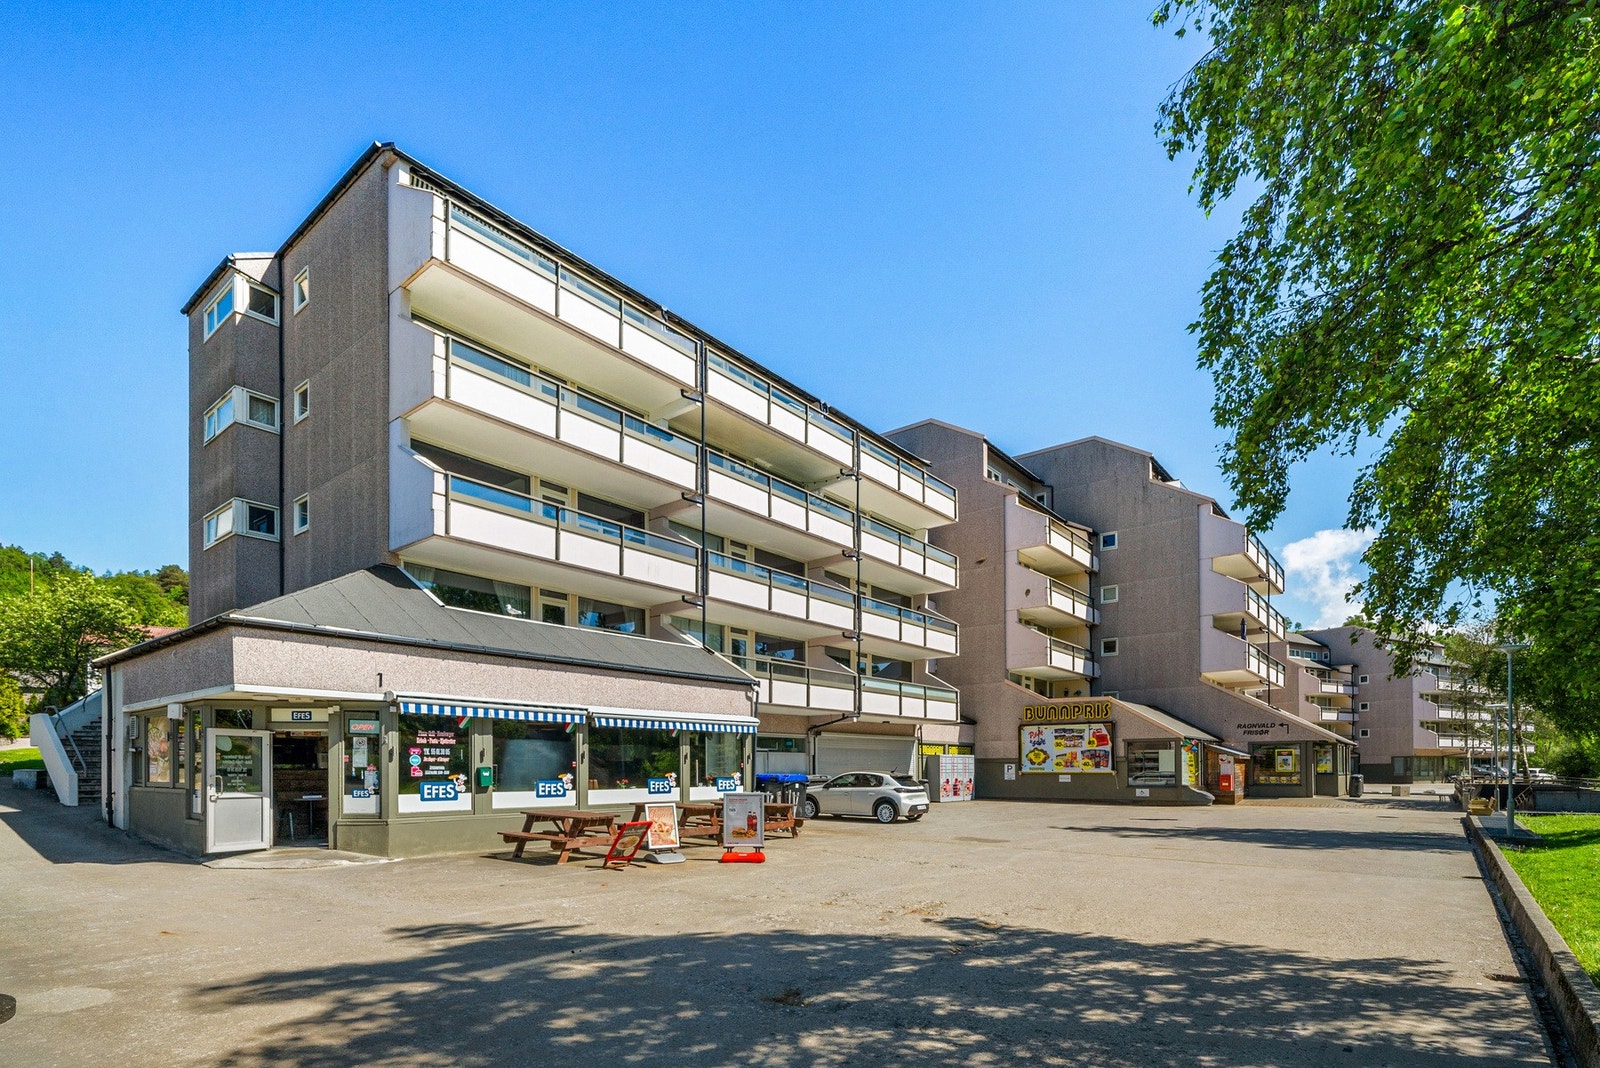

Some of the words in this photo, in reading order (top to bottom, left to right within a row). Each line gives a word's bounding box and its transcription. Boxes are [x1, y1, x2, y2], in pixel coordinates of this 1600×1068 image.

[376, 672, 383, 688] 1
[293, 711, 311, 720] EFES
[1024, 702, 1111, 720] BUNNPRIS
[351, 723, 375, 731] OPEN
[1006, 765, 1013, 773] P
[538, 782, 564, 796] EFES
[650, 780, 670, 792] EFES
[718, 779, 735, 790] EFES
[353, 789, 370, 798] EFES
[423, 784, 455, 798] EFES
